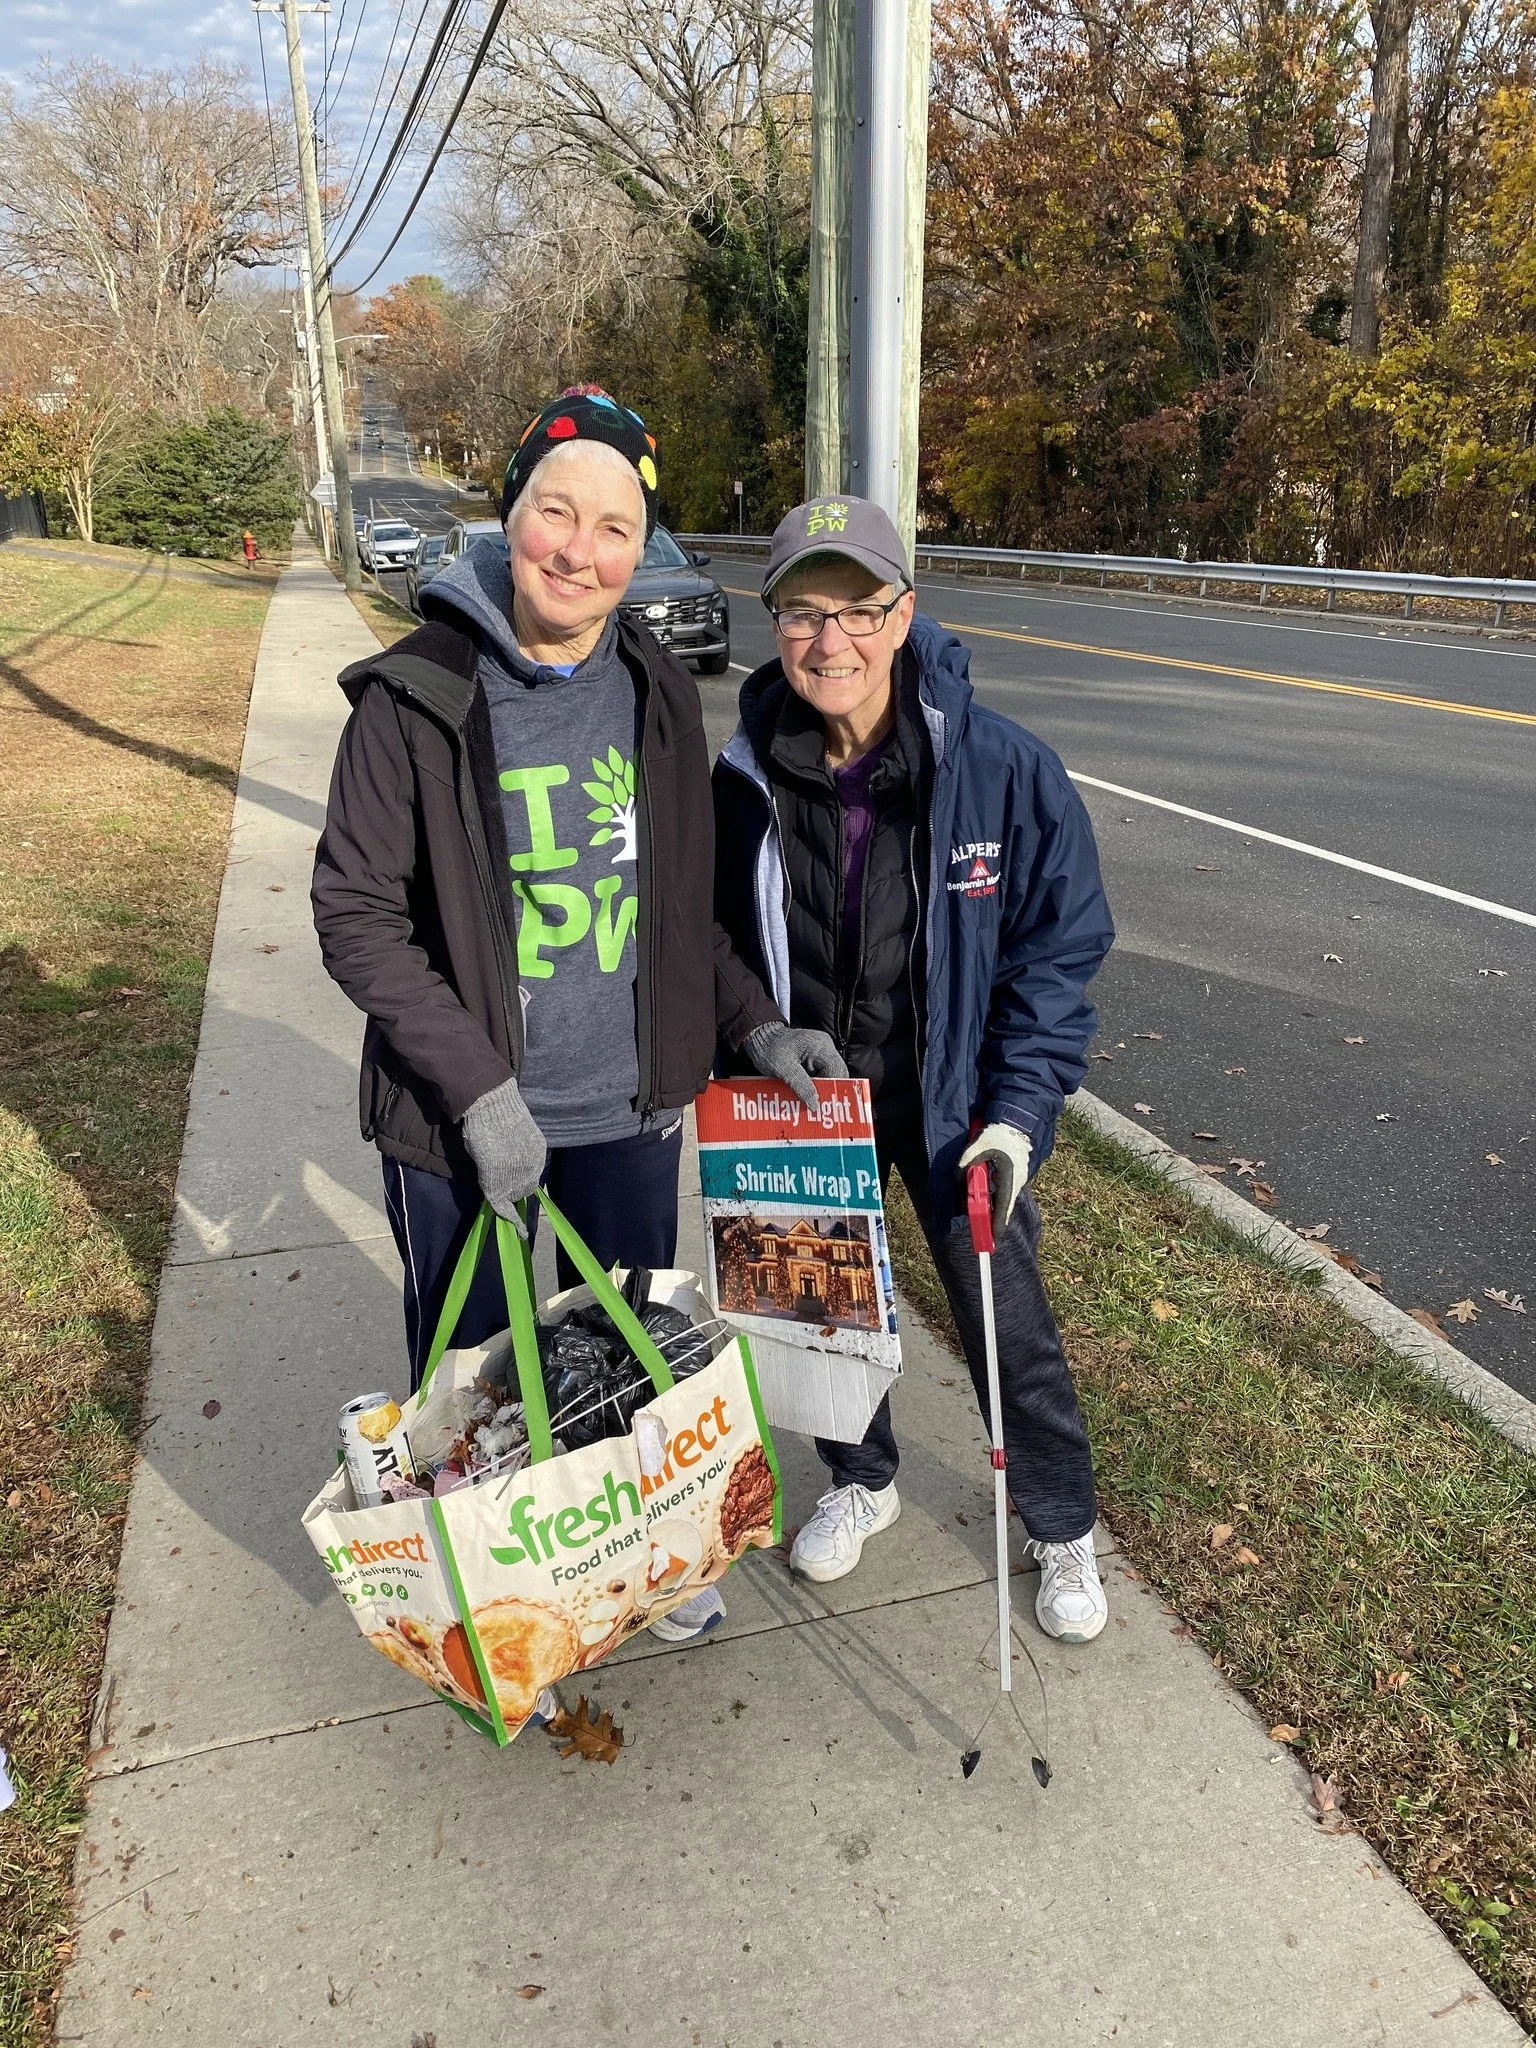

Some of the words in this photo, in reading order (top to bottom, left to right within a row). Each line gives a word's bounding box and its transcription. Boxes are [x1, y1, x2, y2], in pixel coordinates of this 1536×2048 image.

[806, 517, 848, 536] PW
[809, 505, 824, 520] I
[499, 764, 579, 872] I
[951, 842, 1001, 864] ALPER'S
[947, 878, 985, 892] Benjamin
[732, 1092, 800, 1126] Holiday
[735, 1162, 798, 1194] Shrink
[801, 1166, 852, 1205] Wrap
[507, 1395, 732, 1567] freshrect
[551, 1549, 602, 1586] Food
[604, 1527, 642, 1558] that
[646, 1482, 695, 1535] elivers
[697, 1458, 727, 1491] you.
[359, 1566, 401, 1579] delivers
[403, 1567, 422, 1579] you.
